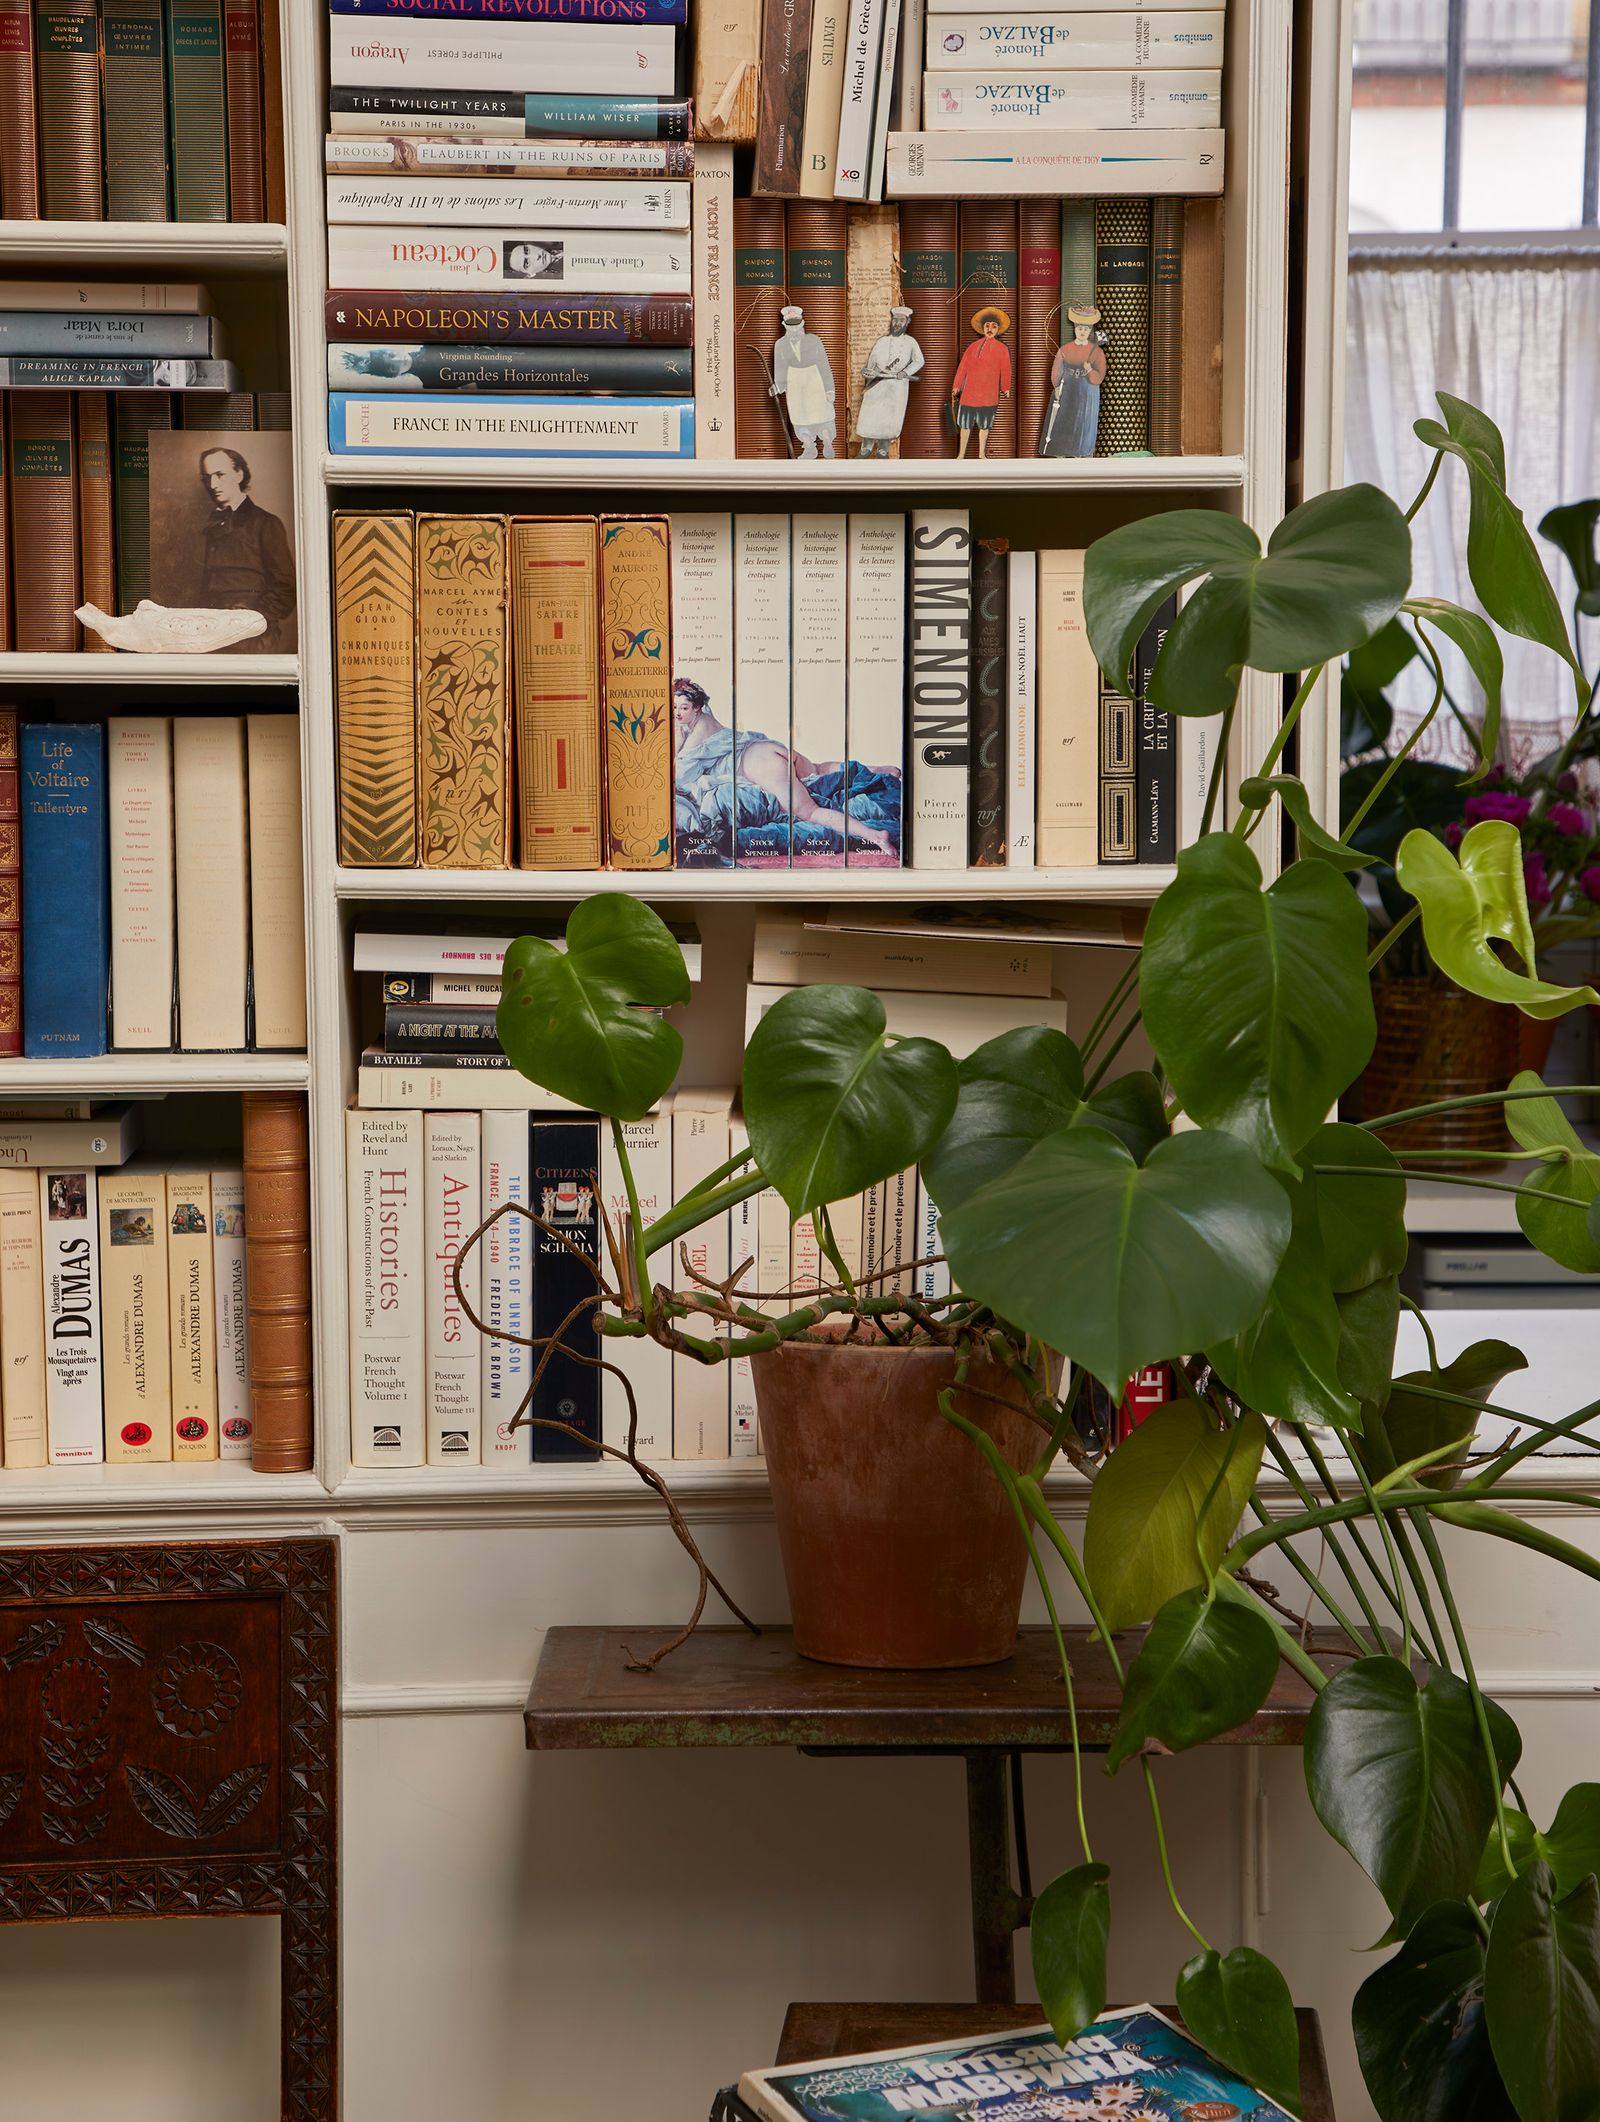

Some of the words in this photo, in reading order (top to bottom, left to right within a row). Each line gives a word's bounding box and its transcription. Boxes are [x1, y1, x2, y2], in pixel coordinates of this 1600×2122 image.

[858, 0, 872, 36] Grèce
[979, 26, 1056, 45] BALZAC
[1055, 29, 1070, 40] de
[1135, 15, 1143, 55] COMÉDIE
[1142, 20, 1150, 60] HUMAINE
[1173, 34, 1214, 42] omnibus
[821, 16, 837, 66] STATUES
[350, 41, 410, 66] Aragon
[856, 40, 868, 56] de
[994, 45, 1045, 57] Honoré
[427, 49, 460, 60] FOREST
[462, 49, 503, 61] PHILIPPE
[1135, 56, 1143, 66] LA
[852, 59, 866, 103] Michel
[975, 85, 1052, 104] BALZAC
[1051, 88, 1066, 98] de
[1131, 74, 1139, 113] COMÉDIE
[1138, 79, 1146, 119] HUMAINE
[1168, 93, 1208, 102] omnibus
[352, 97, 381, 108] THE
[389, 98, 459, 111] TWILIGHT
[465, 100, 507, 112] YEARS
[991, 104, 1041, 116] Honoré
[543, 111, 597, 122] WILLIAM
[602, 112, 641, 123] WISER
[1131, 114, 1138, 125] LA
[380, 119, 408, 129] PARIS
[411, 120, 419, 129] IN
[423, 120, 444, 129] THE
[448, 121, 477, 130] 1930s
[334, 146, 390, 158] BROOKS
[775, 124, 785, 172] Flammarion
[421, 148, 492, 160] FLAUBERT
[496, 149, 512, 160] IN
[517, 149, 545, 160] THE
[551, 150, 593, 162] RUINS
[598, 151, 617, 162] OF
[621, 152, 661, 164] PARIS
[908, 143, 916, 177] GEORGES
[916, 143, 925, 177] SIMENON
[1015, 156, 1021, 165] A
[1022, 156, 1033, 165] LA
[1033, 155, 1072, 165] CONQUÊTE
[1072, 156, 1082, 165] DE
[1082, 156, 1101, 166] TIGY
[811, 154, 827, 171] B
[695, 170, 731, 179] PAXTON
[664, 188, 672, 219] PERRIN
[707, 195, 720, 242] VICHY
[392, 243, 497, 273] Cocteau
[570, 255, 607, 267] Arnaud
[609, 256, 644, 268] Claude
[1113, 260, 1146, 268] LANGAGE
[448, 263, 472, 275] Jean
[707, 244, 721, 302] FRANCE
[355, 308, 509, 330] NAPOLEON'S
[517, 309, 618, 331] MASTER
[623, 307, 631, 335] DAVID
[63, 320, 101, 332] Maar
[106, 321, 144, 333] Dora
[185, 323, 194, 343] Stock
[439, 352, 472, 362] Virginia
[473, 353, 513, 363] Rounding
[19, 362, 78, 371] DREAMING
[83, 362, 96, 371] IN
[100, 362, 144, 372] FRENCH
[41, 374, 75, 382] ALICE
[78, 375, 122, 383] KAPLAN
[439, 366, 500, 382] Grandes
[503, 367, 590, 383] Horizontales
[361, 403, 370, 444] ROCHE
[392, 417, 450, 433] FRANCE
[455, 417, 472, 433] IN
[475, 418, 506, 433] THE
[509, 419, 639, 435] ENLIGHTENMENT
[662, 410, 670, 447] HARVARD
[680, 529, 717, 539] Anthologie
[744, 531, 781, 541] Anthologie
[682, 543, 715, 553] historique
[746, 545, 779, 555] historique
[692, 556, 717, 564] lectures
[756, 558, 781, 566] lectures
[611, 563, 659, 573] MAUROIS
[423, 587, 469, 596] MARCEL
[472, 586, 501, 597] AYMÉ
[360, 602, 392, 614] JEAN
[436, 607, 489, 617] CONTES
[355, 614, 396, 625] GIONO
[536, 610, 580, 619] SARTRE
[455, 618, 468, 626] ET
[423, 627, 501, 637] NOUVELLES
[913, 526, 970, 739] SIMENON
[1017, 616, 1026, 645] LIAUT
[341, 640, 411, 652] CHRONIQUES
[341, 655, 411, 667] ROMANESQUES
[1017, 647, 1027, 697] JEAN-NOËL
[608, 688, 667, 700] ROMANTIQUE
[42, 741, 73, 758] Life
[51, 759, 65, 770] of
[27, 771, 90, 787] Voltaire
[923, 798, 957, 808] Pierre
[915, 811, 966, 820] Assouline
[1150, 778, 1159, 844] CALMANN-LÉVY
[750, 838, 774, 847] STOCK
[744, 848, 780, 857] SPENGLER
[441, 952, 476, 960] BRUNHOFF
[479, 953, 492, 961] DES
[40, 1032, 80, 1042] PUTNAM
[374, 1055, 422, 1066] BATAILLE
[361, 1121, 393, 1131] Edited
[394, 1121, 409, 1134] by
[361, 1134, 387, 1143] Revel
[389, 1133, 409, 1143] and
[431, 1135, 450, 1143] Edited
[450, 1135, 462, 1144] by
[361, 1146, 389, 1156] Hunt
[431, 1154, 443, 1162] and
[443, 1153, 468, 1162] Slatkin
[363, 1169, 373, 1202] French
[742, 1199, 750, 1225] PIERRE
[365, 1203, 374, 1281] Constructions
[379, 1167, 408, 1311] Histories
[435, 1173, 470, 1344] Antiquities
[52, 1238, 92, 1340] DUMAS
[365, 1282, 374, 1293] of
[51, 1274, 60, 1315] Alexandre
[365, 1292, 374, 1306] the
[365, 1306, 373, 1329] Past
[56, 1348, 68, 1357] Les
[69, 1347, 88, 1356] Trois
[47, 1355, 97, 1367] Mousquetaires
[363, 1354, 402, 1364] Postwar
[56, 1368, 74, 1380] Vingt
[75, 1369, 88, 1377] ans
[363, 1366, 397, 1375] French
[434, 1371, 466, 1380] Postwar
[363, 1378, 406, 1391] Thought
[434, 1382, 462, 1391] French
[434, 1394, 469, 1404] Thought
[736, 1403, 753, 1411] Albin
[881, 2050, 1158, 2112] МАВРИНА
